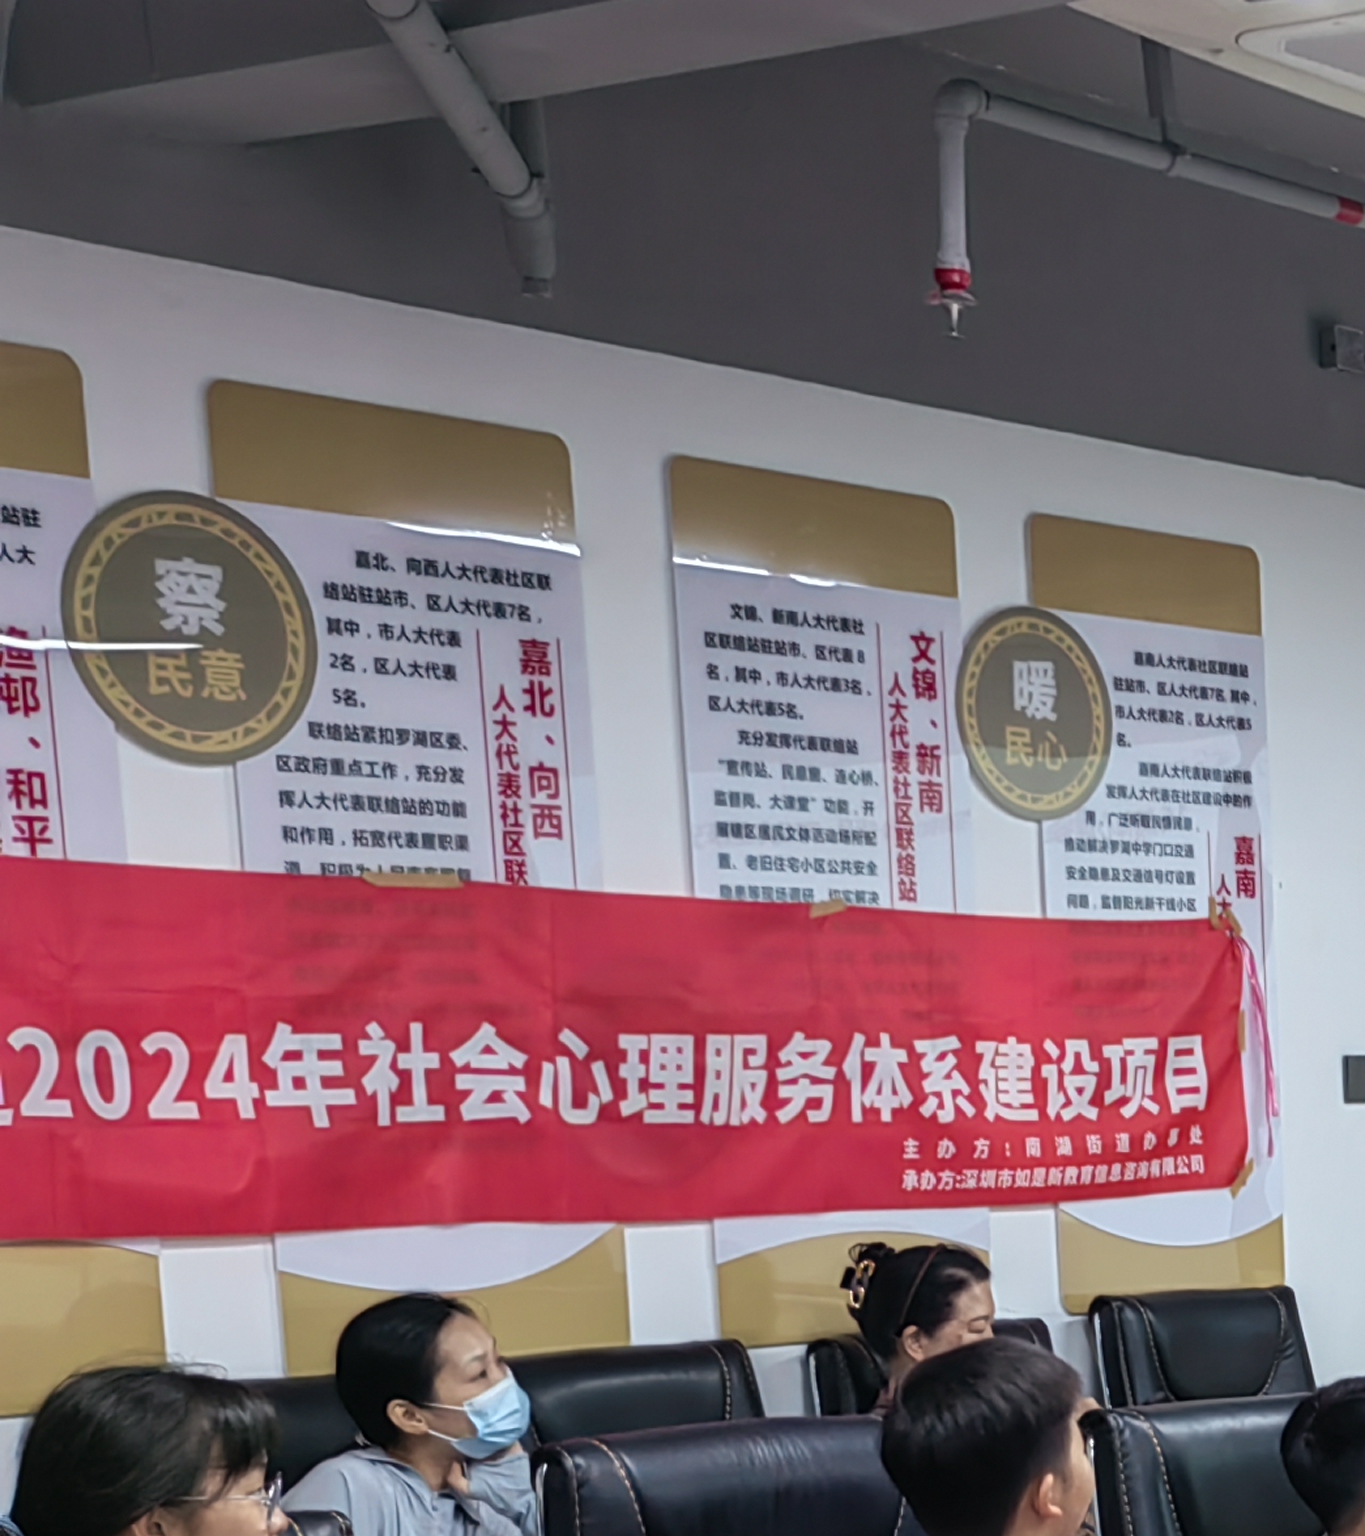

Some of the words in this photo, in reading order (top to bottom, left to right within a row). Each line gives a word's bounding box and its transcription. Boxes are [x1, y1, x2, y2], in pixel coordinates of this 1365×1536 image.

[154, 556, 228, 637] 察
[146, 648, 248, 702] 民意
[1012, 660, 1058, 722] 暖
[518, 637, 564, 842] 嘉北、向西
[909, 630, 945, 815] 文锦、新南
[1005, 724, 1068, 771] 民心
[491, 682, 529, 886] 人大代表社区联
[888, 671, 918, 904] 人大代表社区联络站
[1233, 835, 1257, 900] 嘉南
[0, 1021, 1207, 1129] 2024年社会心理服务体系建设项目
